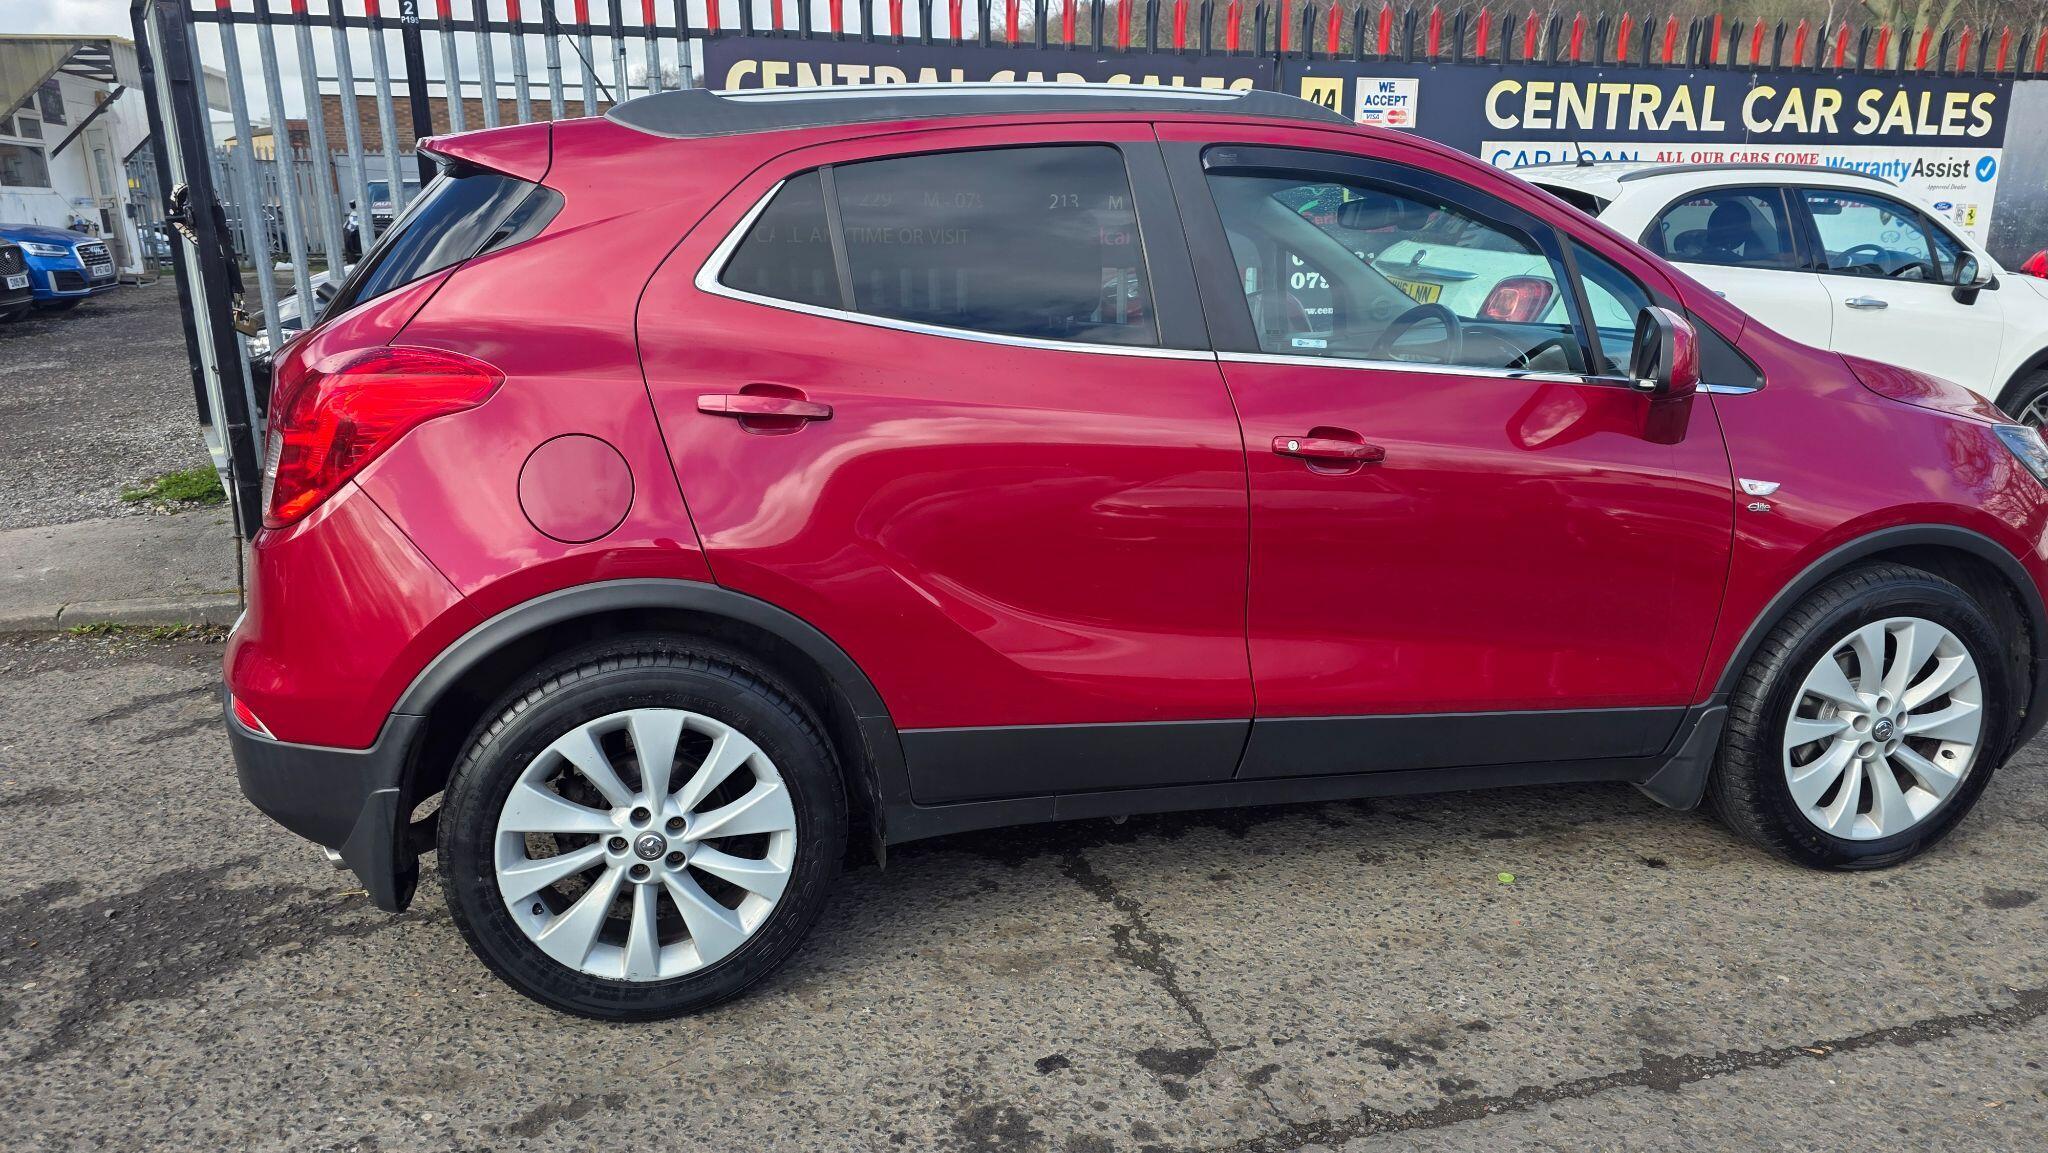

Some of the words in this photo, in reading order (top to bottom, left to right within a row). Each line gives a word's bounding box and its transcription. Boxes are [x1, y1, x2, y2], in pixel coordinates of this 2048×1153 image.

[404, 1, 414, 15] 2
[1379, 81, 1396, 93] WE
[1364, 95, 1408, 107] ACCEPT
[1485, 79, 1726, 132] CENTRAL
[1742, 85, 1843, 134] CAR
[1853, 88, 1997, 137] SALES
[1656, 151, 1685, 163] ALL
[1690, 152, 1725, 164] OUR
[1730, 152, 1770, 164] CARS
[1775, 153, 1820, 165] COME
[928, 228, 970, 244] VISIT
